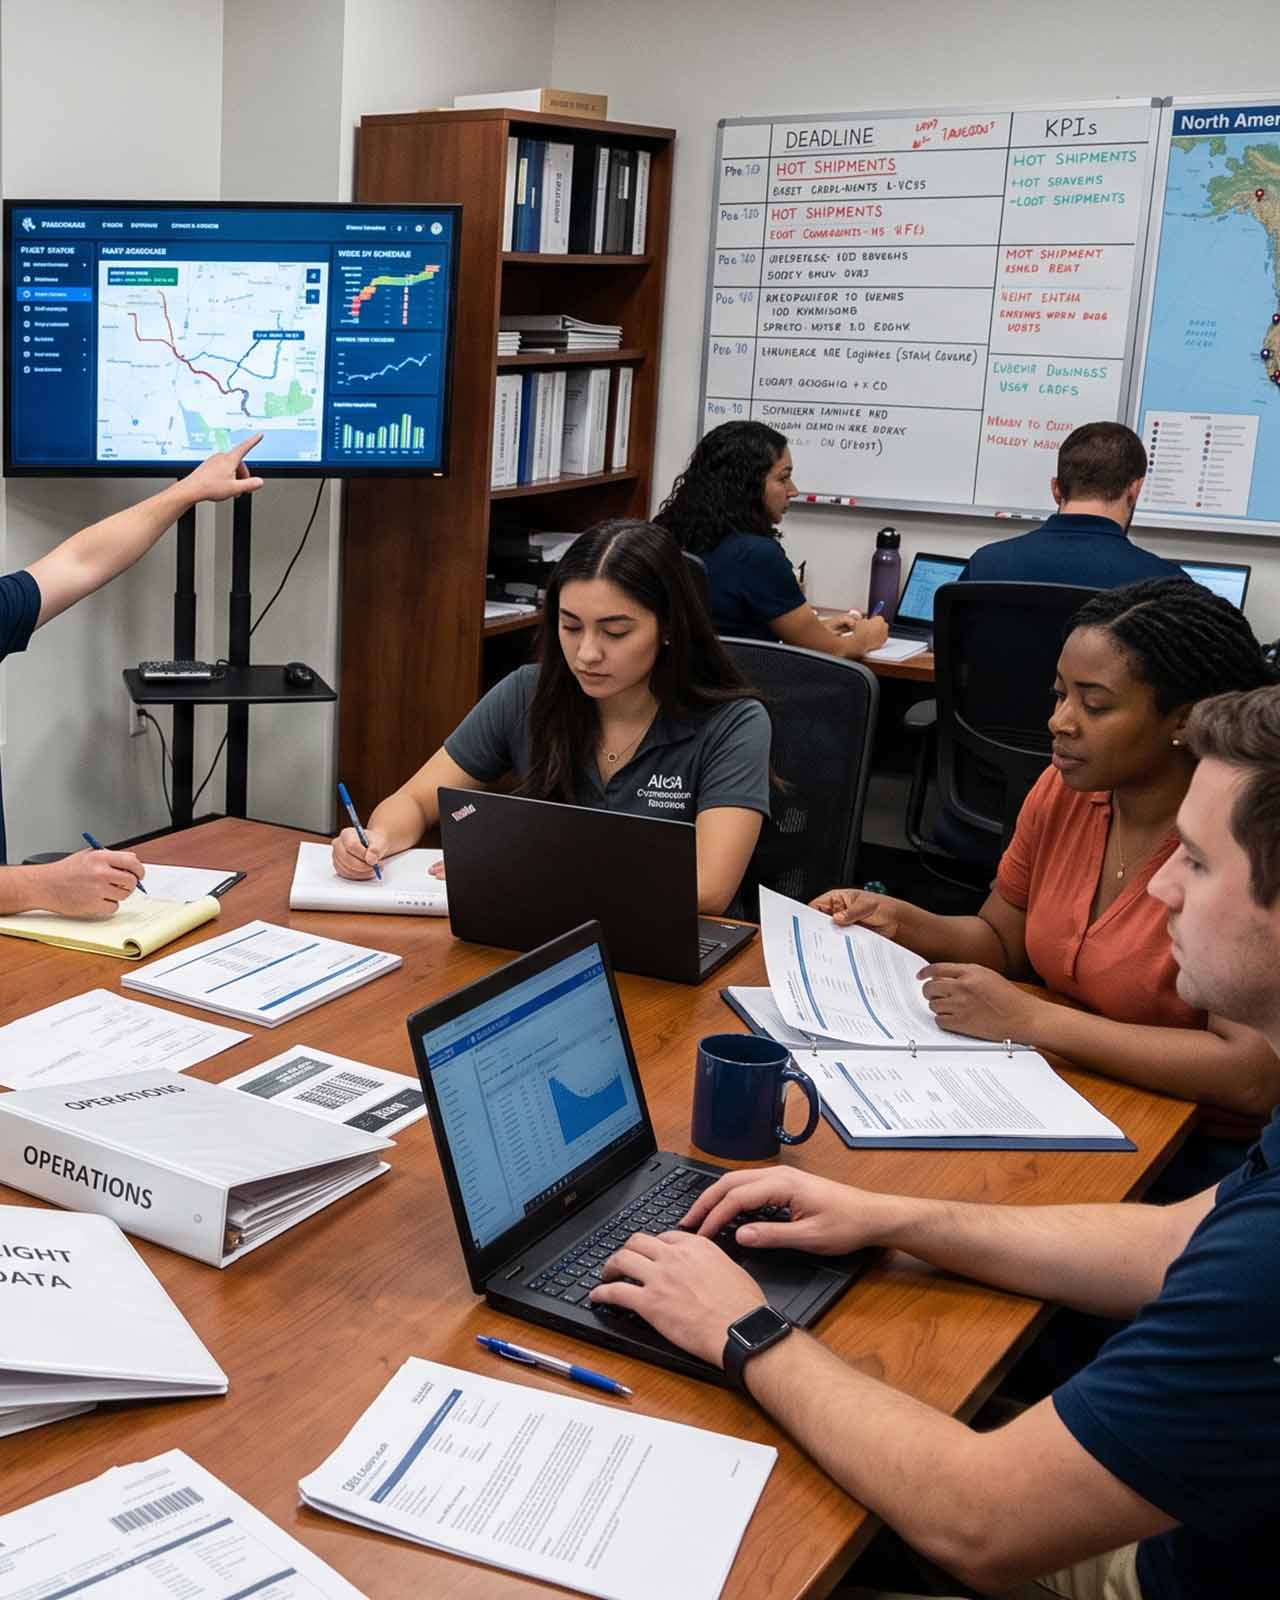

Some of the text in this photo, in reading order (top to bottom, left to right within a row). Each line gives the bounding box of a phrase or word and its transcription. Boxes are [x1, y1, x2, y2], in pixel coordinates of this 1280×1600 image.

[1045, 117, 1098, 138] KPIs
[1181, 113, 1229, 130] North
[785, 128, 874, 149] DEADLINE
[776, 158, 896, 177] HOT SHIPMENTS
[1013, 150, 1137, 167] HOT SHIPMENTS
[1053, 193, 1125, 207] SHIPMENTS
[771, 205, 883, 221] HOT SHIPMENTS
[1040, 249, 1104, 260] SHIPMENT
[65, 1084, 186, 1111] OPERATIONS
[23, 1145, 153, 1209] OPERATIONS
